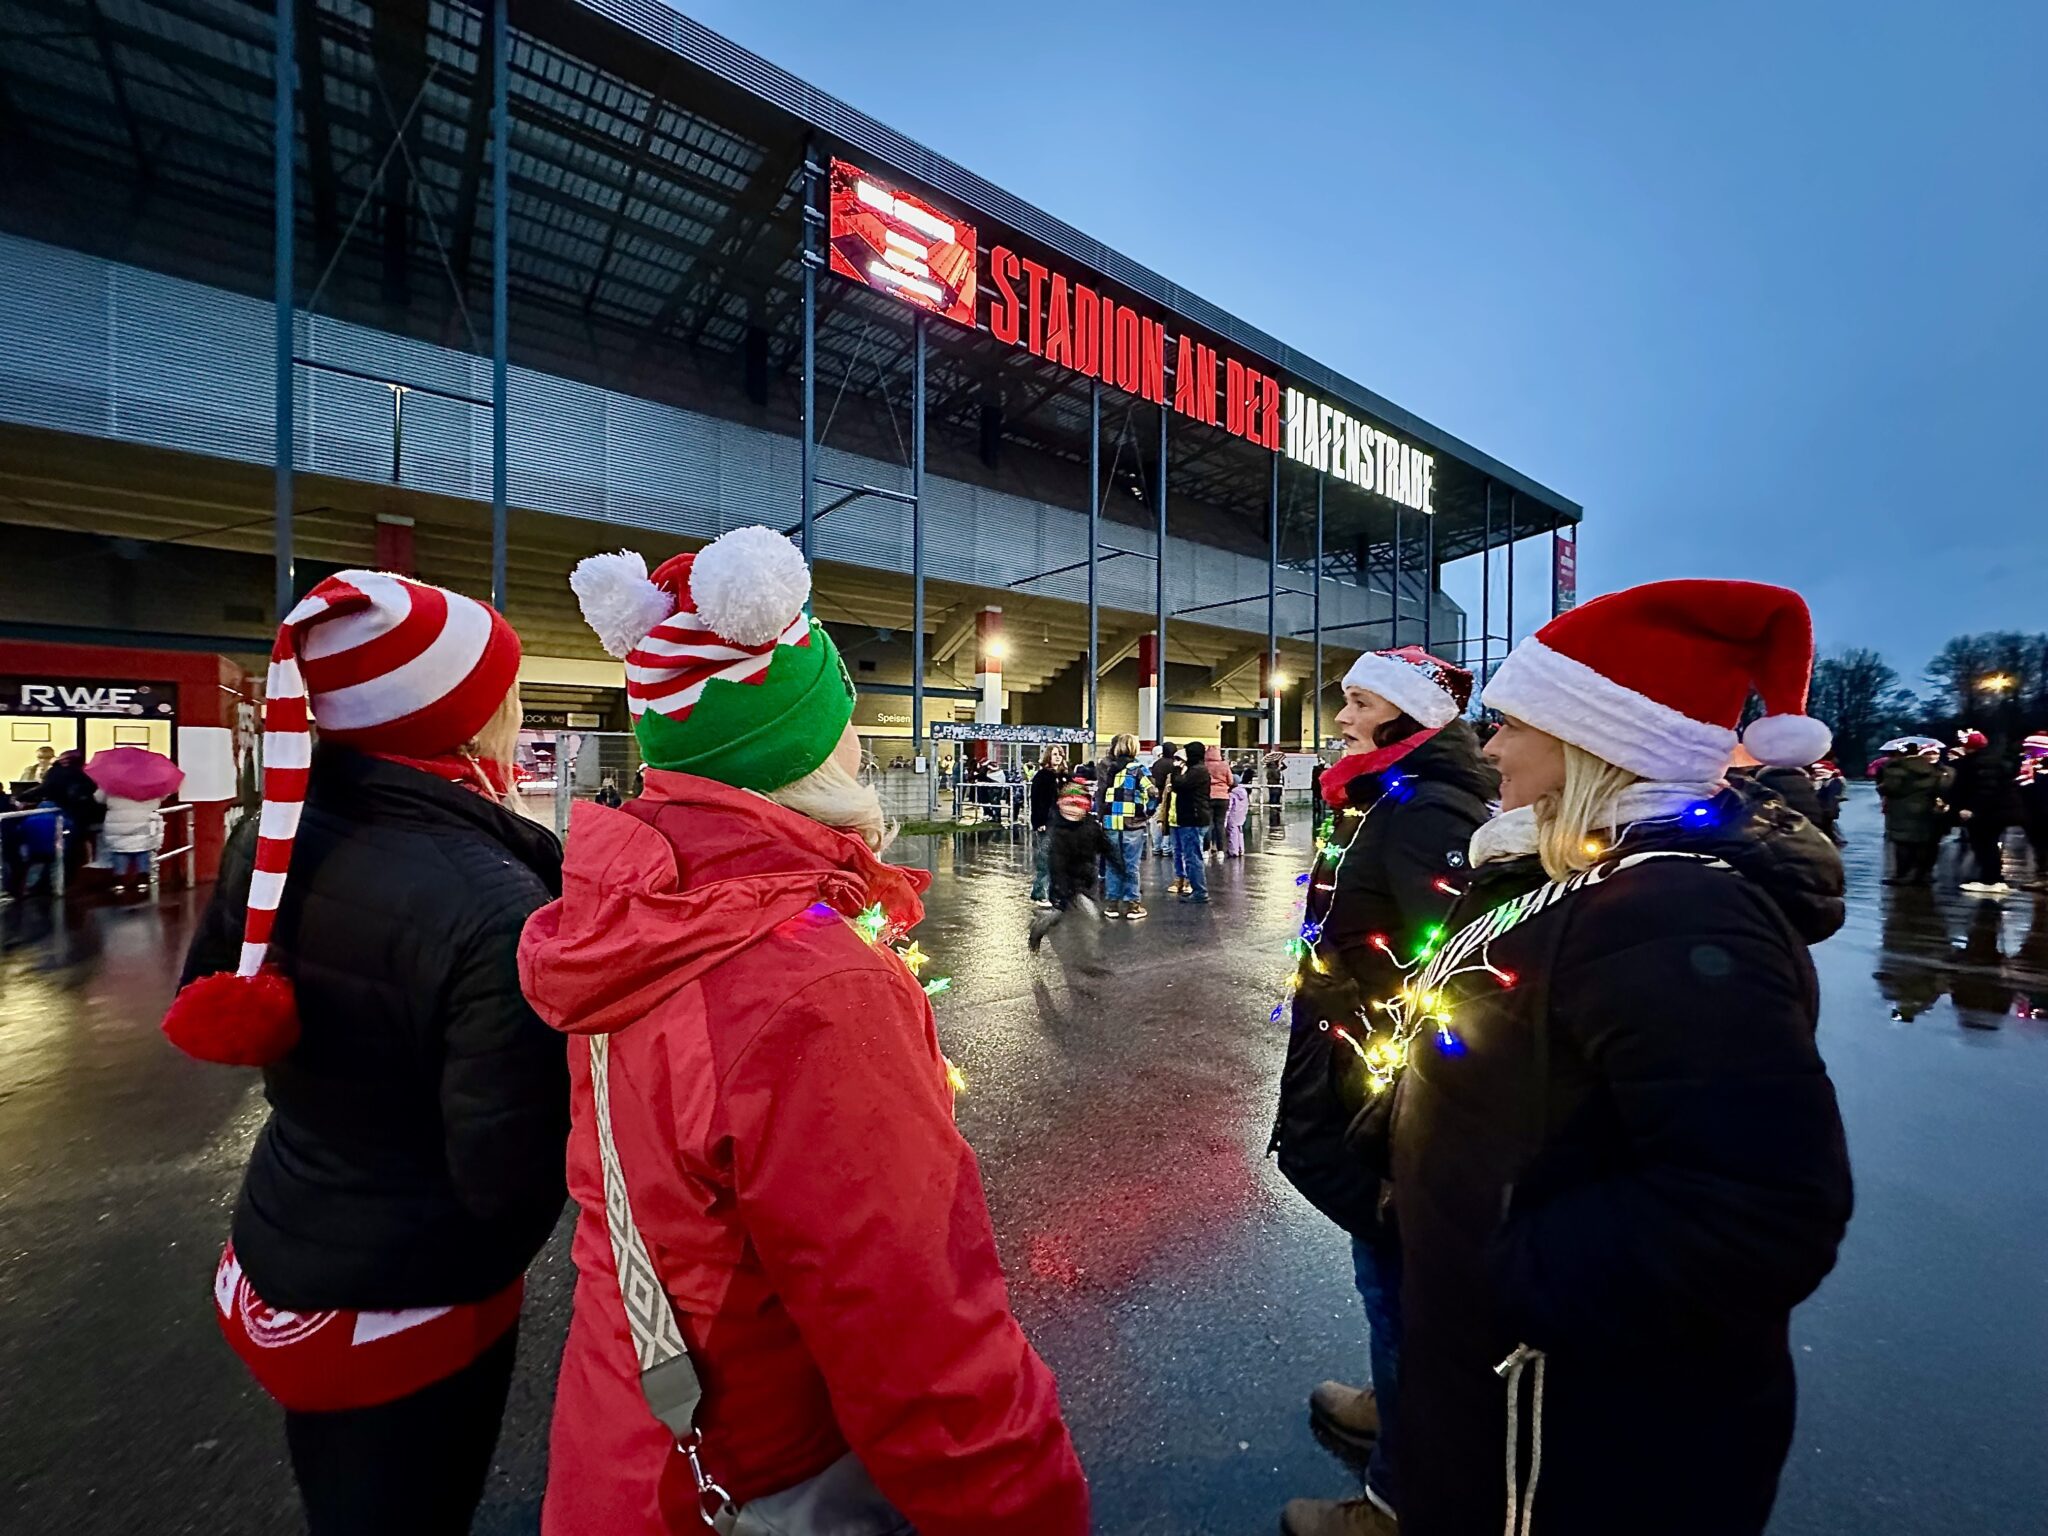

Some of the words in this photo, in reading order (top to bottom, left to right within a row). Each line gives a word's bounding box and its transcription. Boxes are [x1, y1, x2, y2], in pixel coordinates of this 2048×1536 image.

[991, 245, 1164, 405] STADION
[1174, 334, 1216, 426] AN
[1227, 358, 1280, 451] DER
[21, 685, 137, 708] RWE
[877, 713, 911, 723] Speisen
